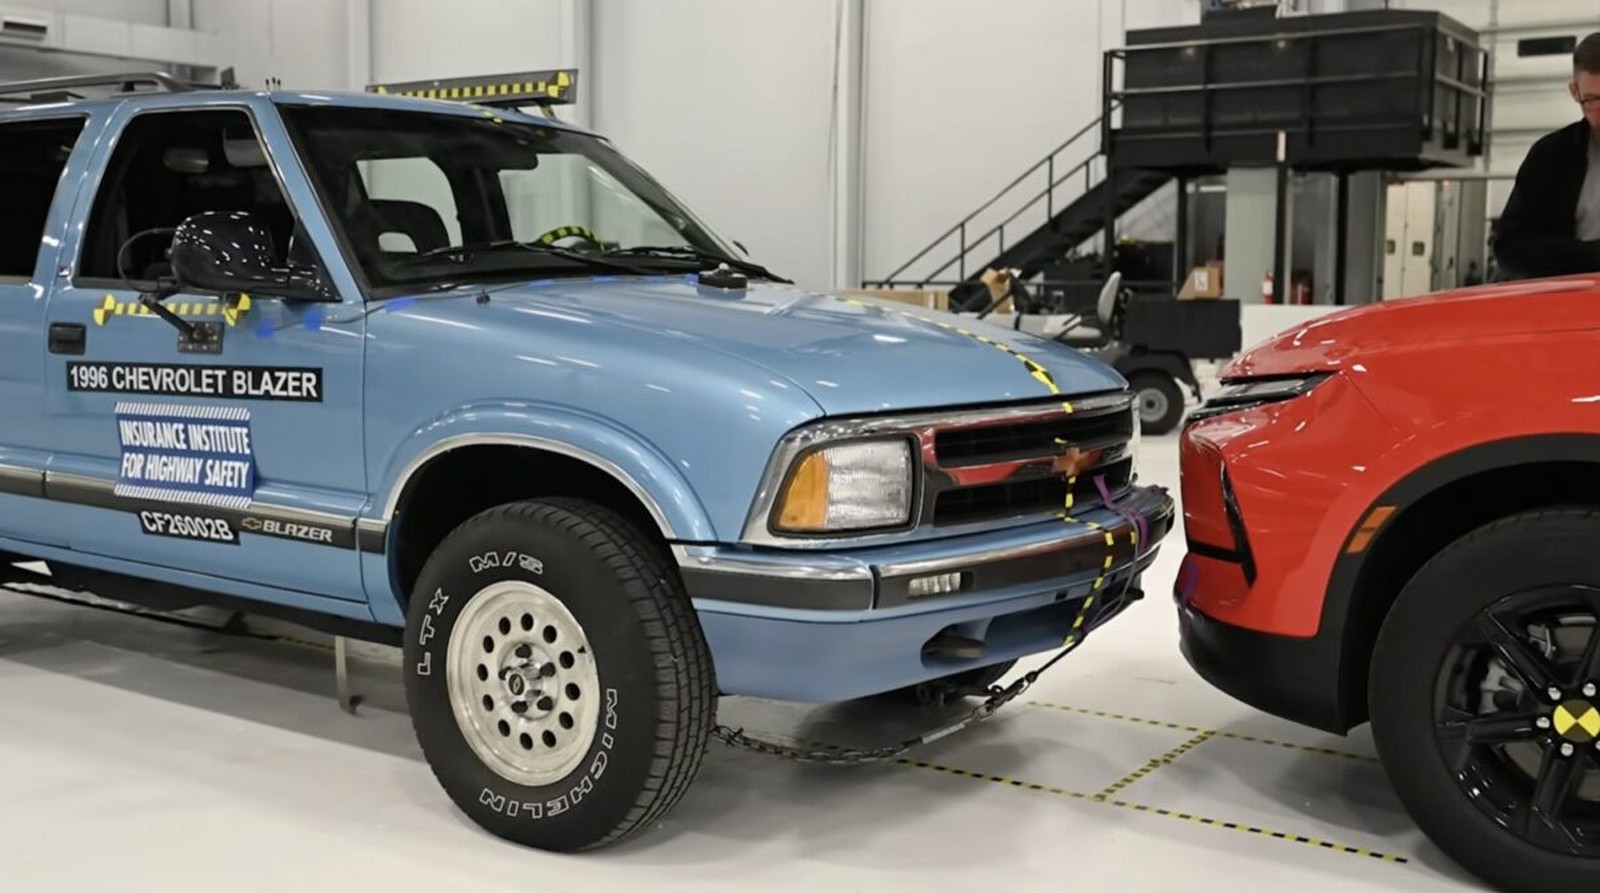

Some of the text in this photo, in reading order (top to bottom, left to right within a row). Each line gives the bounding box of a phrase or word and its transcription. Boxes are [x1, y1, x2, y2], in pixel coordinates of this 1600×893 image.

[70, 366, 317, 397] 1996 CHEVROLET BLAZER
[119, 420, 250, 454] INSURANCE INSTITUTE
[121, 452, 249, 488] FOR HIGHWAY SAFETY
[140, 511, 234, 540] CF26002B
[262, 521, 332, 542] BLAZER
[418, 551, 543, 675] LTX M/S
[479, 689, 618, 818] MICHELIN
